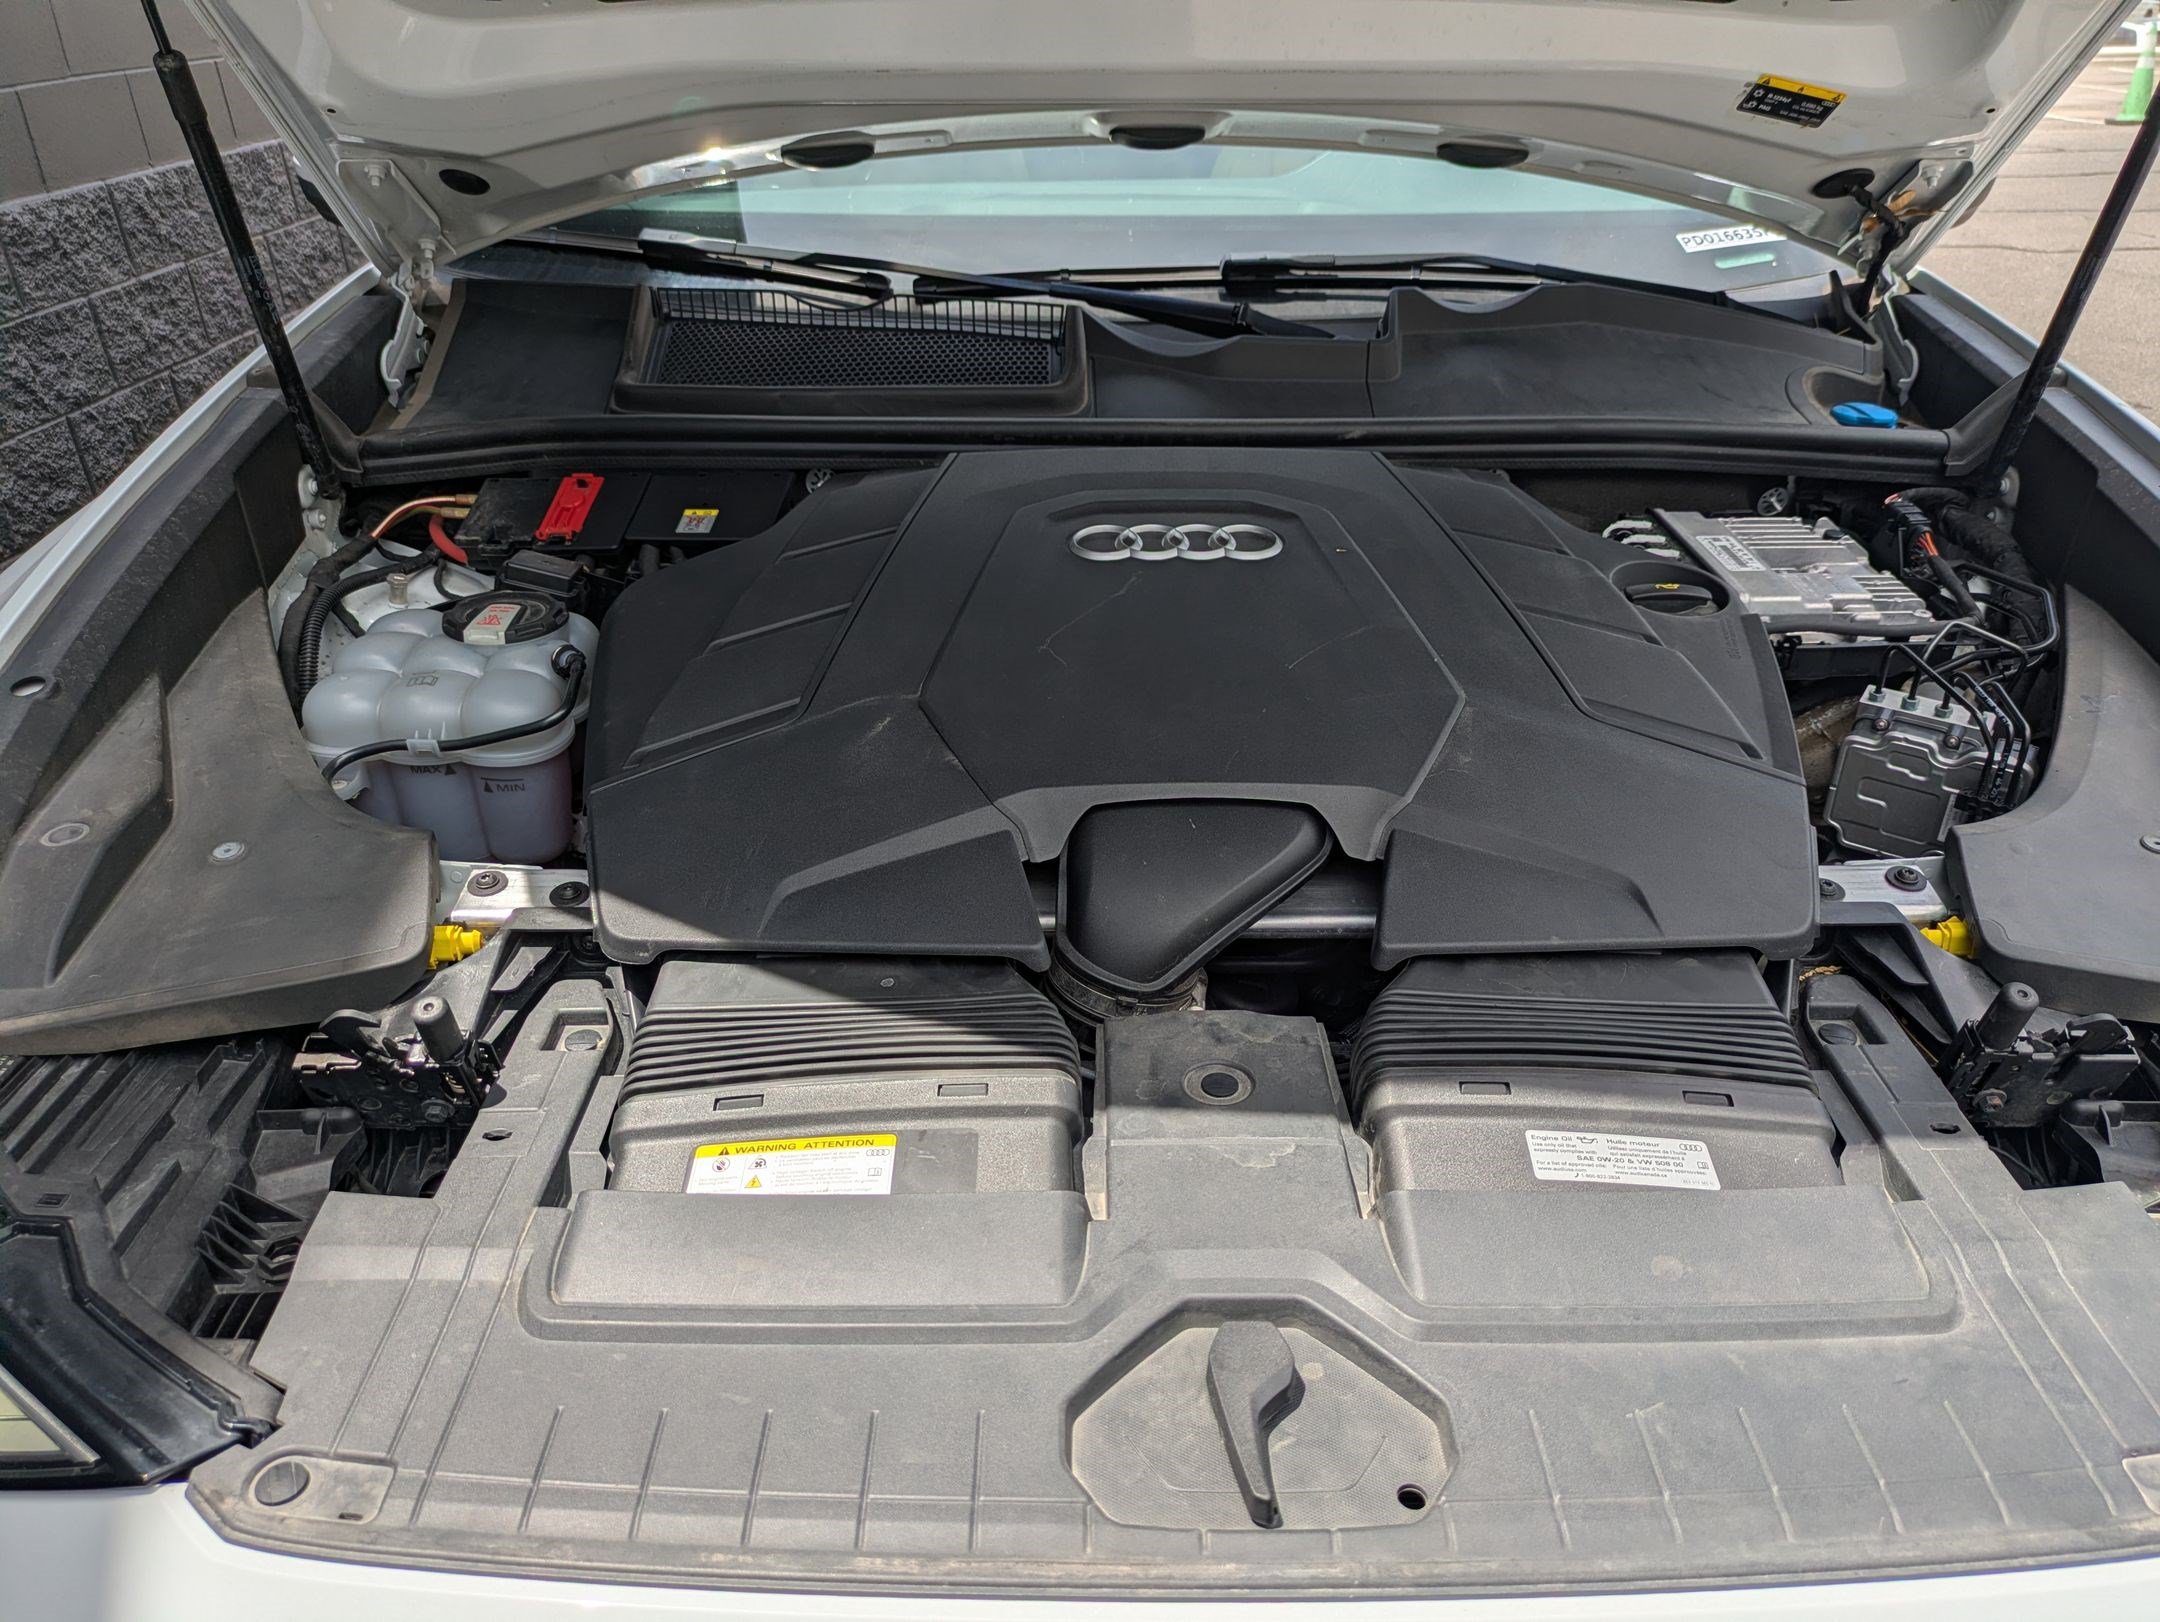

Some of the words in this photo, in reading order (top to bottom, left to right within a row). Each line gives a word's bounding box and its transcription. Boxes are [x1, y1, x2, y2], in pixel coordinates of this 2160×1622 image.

[410, 766, 442, 774] MAX
[496, 783, 526, 792] MIN
[1530, 1134, 1559, 1142] Engine
[735, 1142, 797, 1155] WARNING
[803, 1138, 875, 1150] ATTENTION
[1596, 1156, 1625, 1164] 0W-20
